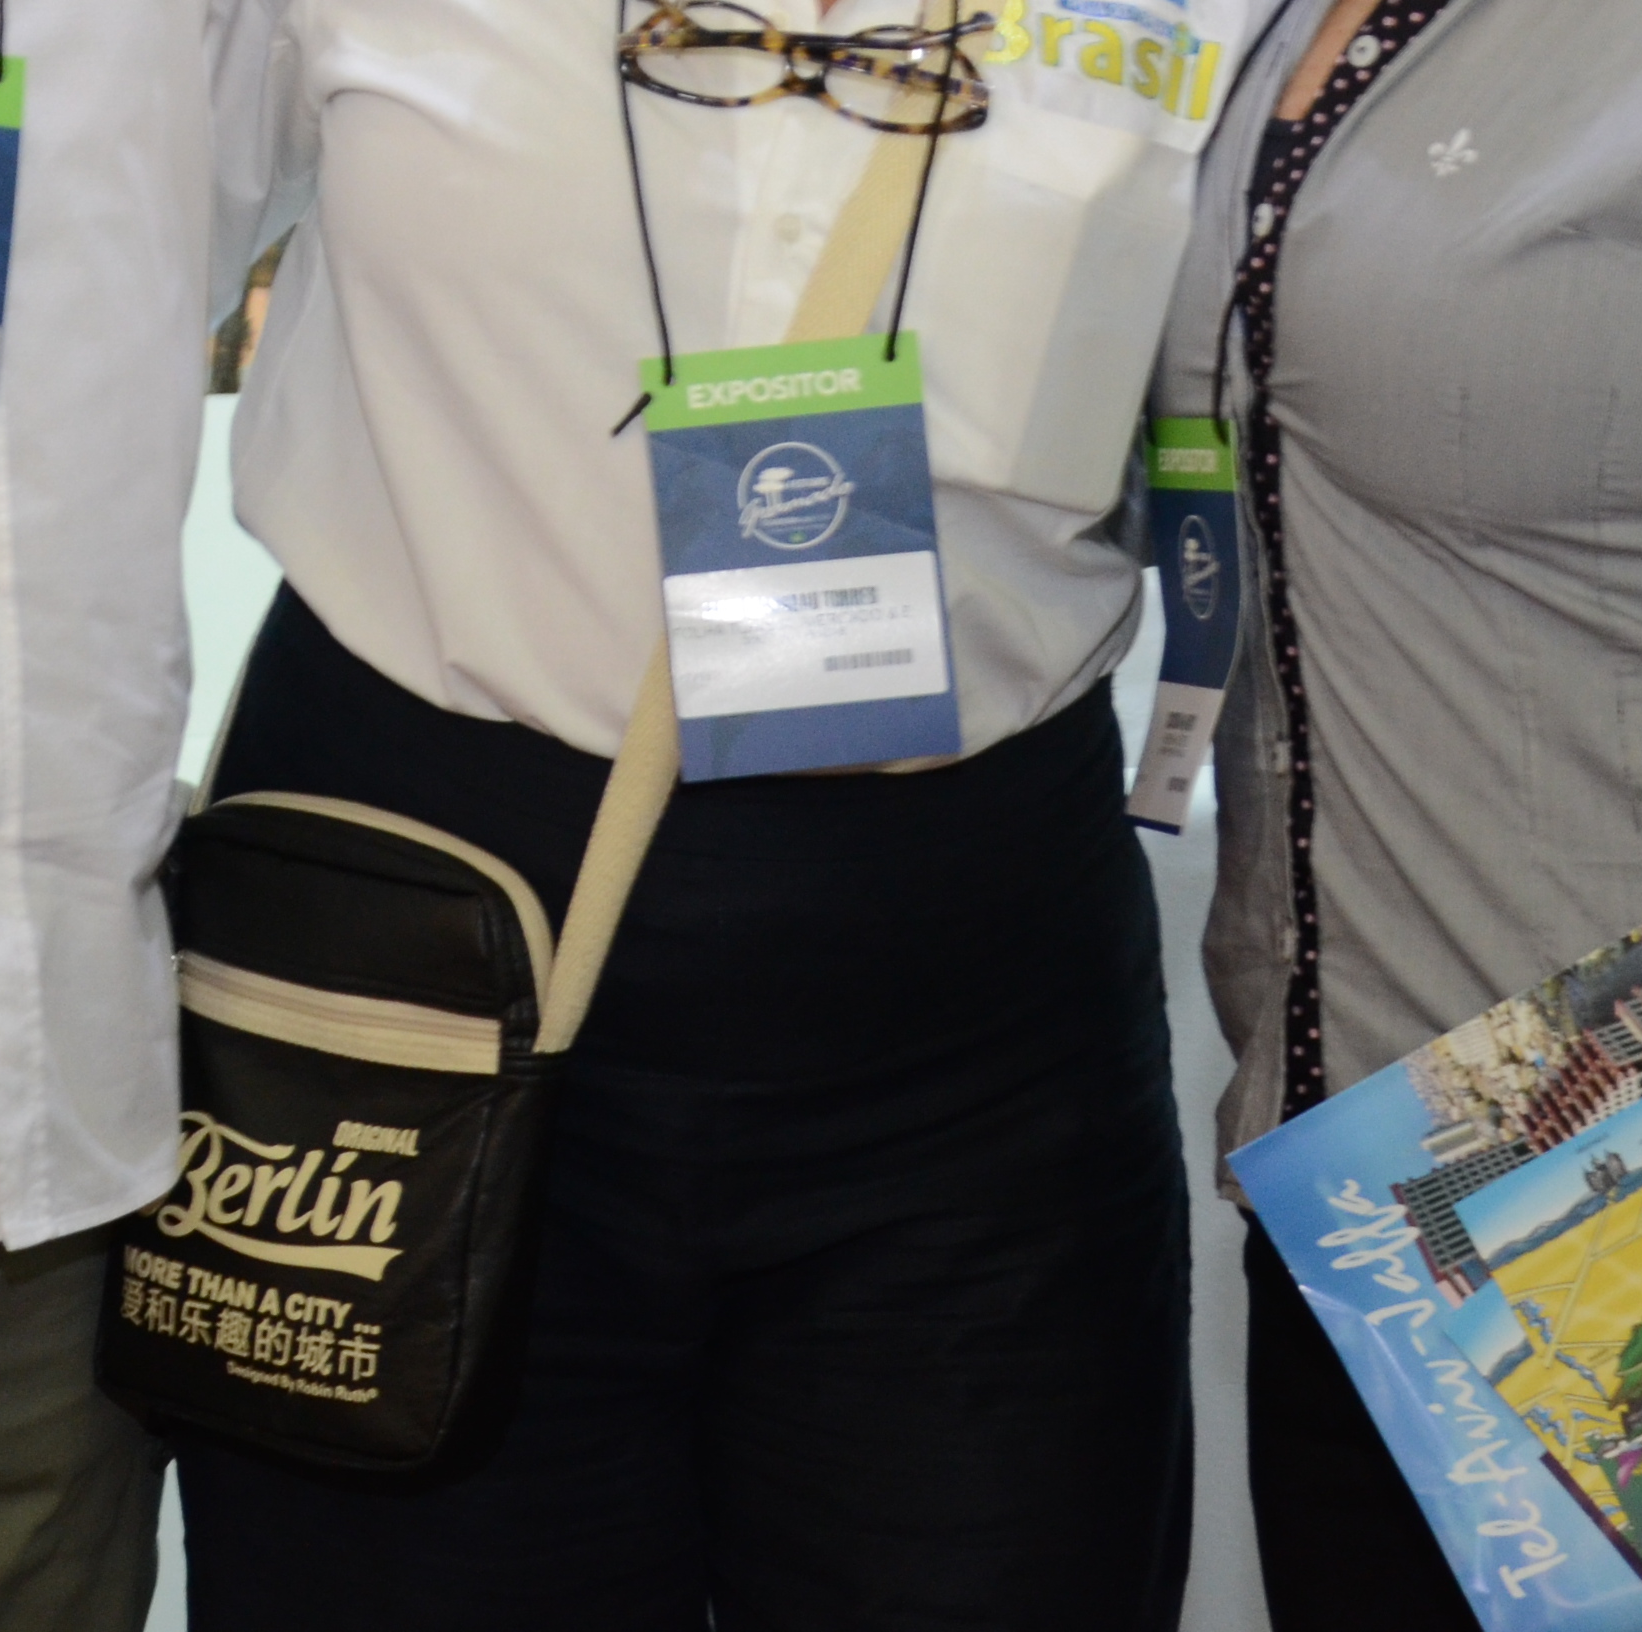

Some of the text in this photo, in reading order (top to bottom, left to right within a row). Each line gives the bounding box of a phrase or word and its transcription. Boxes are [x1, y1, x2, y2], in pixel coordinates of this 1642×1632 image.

[686, 368, 861, 409] EXPOSITOR
[332, 1120, 420, 1156] ORIGINAL
[187, 1266, 258, 1310] THAN
[257, 1287, 281, 1317] A
[284, 1292, 354, 1330] CITY
[295, 1378, 334, 1399] Robin
